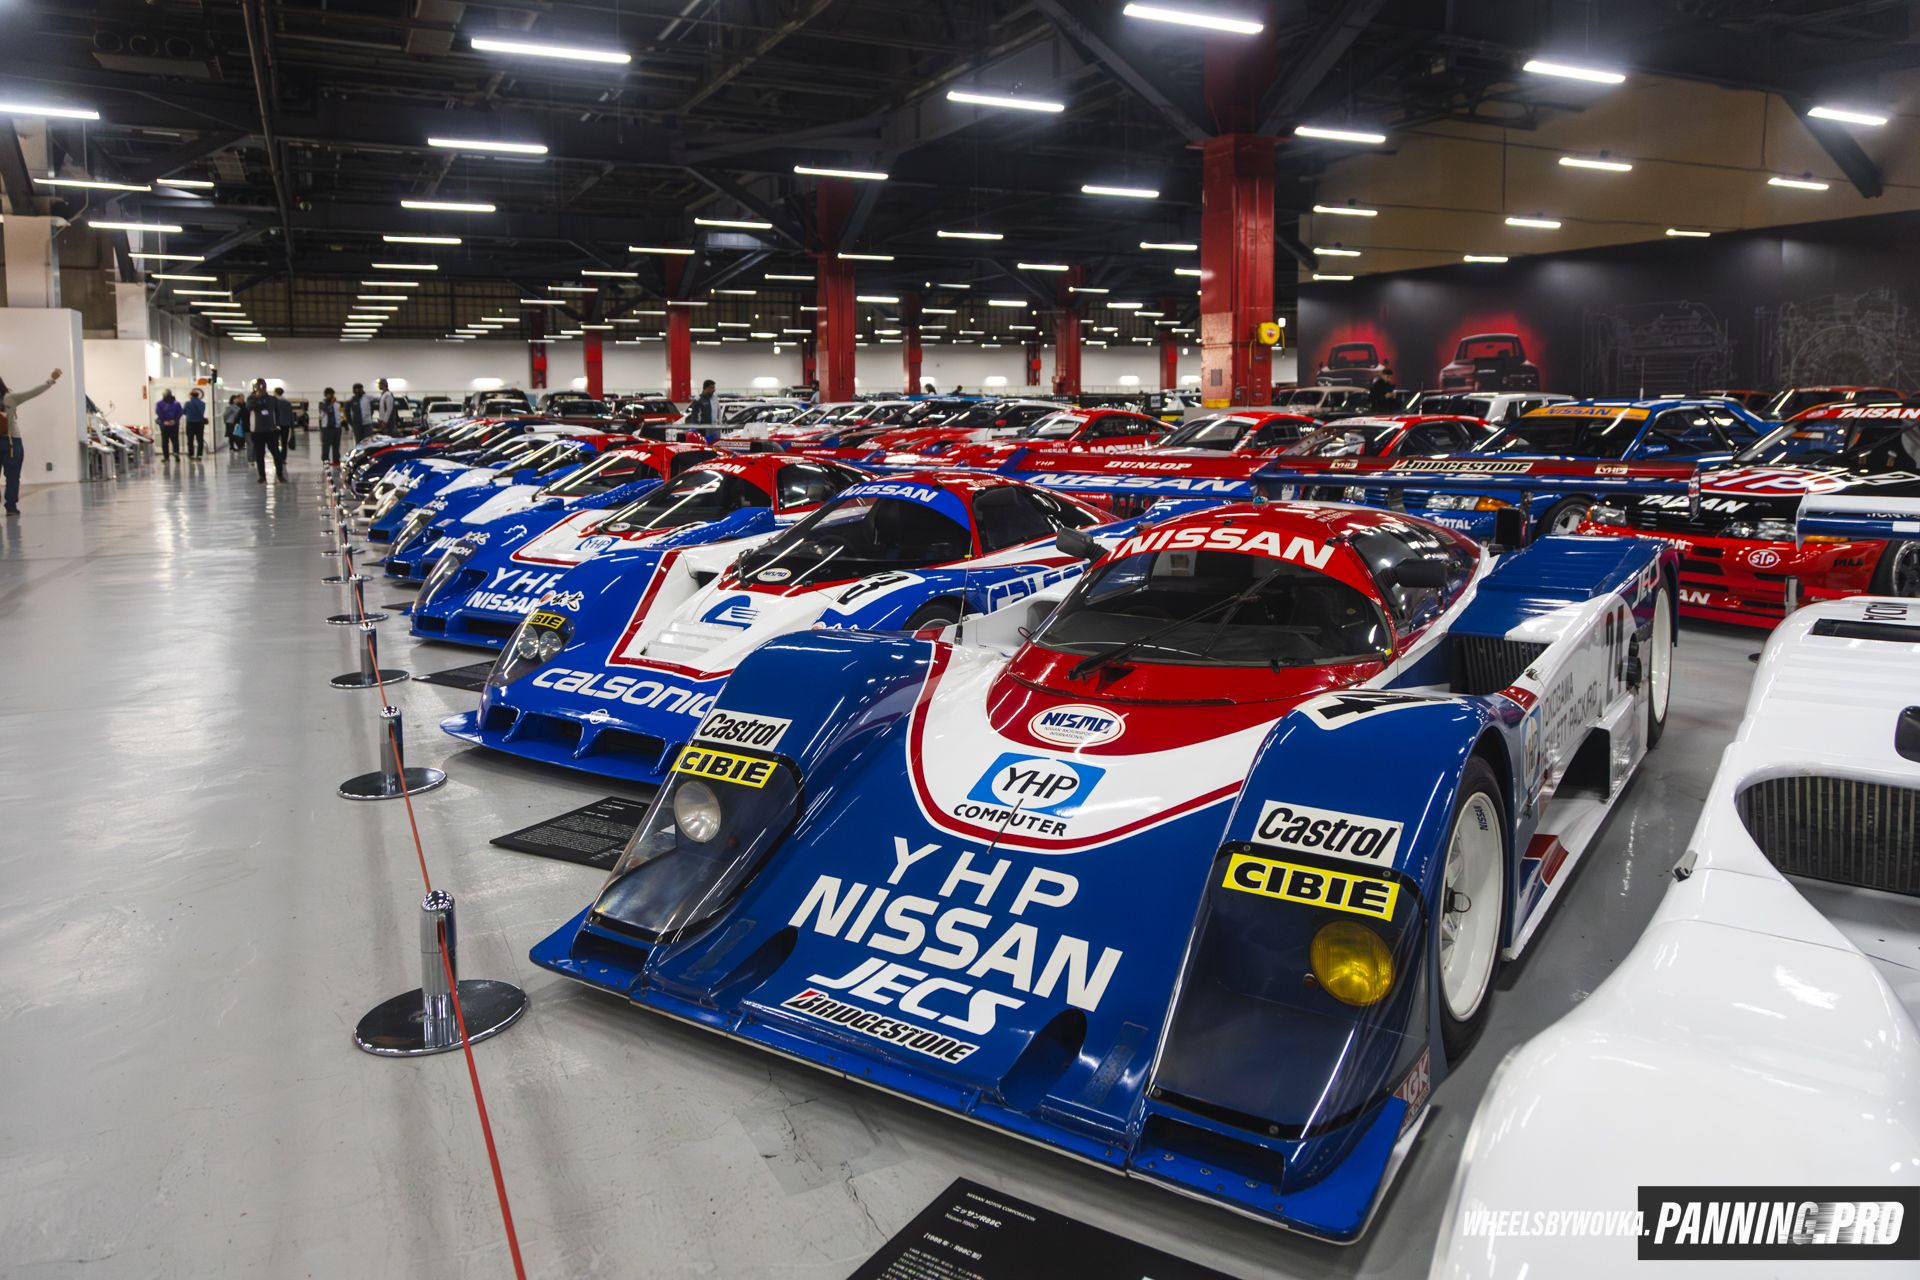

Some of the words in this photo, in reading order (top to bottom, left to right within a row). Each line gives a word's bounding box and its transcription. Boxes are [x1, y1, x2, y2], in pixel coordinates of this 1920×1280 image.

[1547, 407, 1612, 416] NISSAN
[1837, 408, 1920, 419] TAISAN
[685, 462, 747, 474] NISSAN
[1104, 460, 1192, 470] DUNLOP
[1389, 459, 1534, 473] BRIDGESTONE
[840, 483, 939, 503] NISSAN
[1025, 473, 1246, 492] NISSAN
[585, 539, 611, 549] YHP
[1114, 526, 1335, 569] NISSAN
[1751, 551, 1775, 565] STP
[1833, 558, 1864, 568] PIAA
[700, 713, 787, 746] Castrol
[1040, 711, 1115, 734] NISMO
[1002, 767, 1078, 799] YHP
[953, 803, 1067, 837] COMPUTER
[1473, 805, 1489, 831] NISSAN
[1258, 807, 1397, 859] Castrol
[788, 875, 1123, 1012] NISSAN
[805, 957, 1025, 1035] JECS
[787, 988, 978, 1063] BRIDGESTONE
[966, 1192, 985, 1203] NISSAN
[985, 1199, 1002, 1209] MOTOR
[1002, 1205, 1036, 1222] CORPORATION
